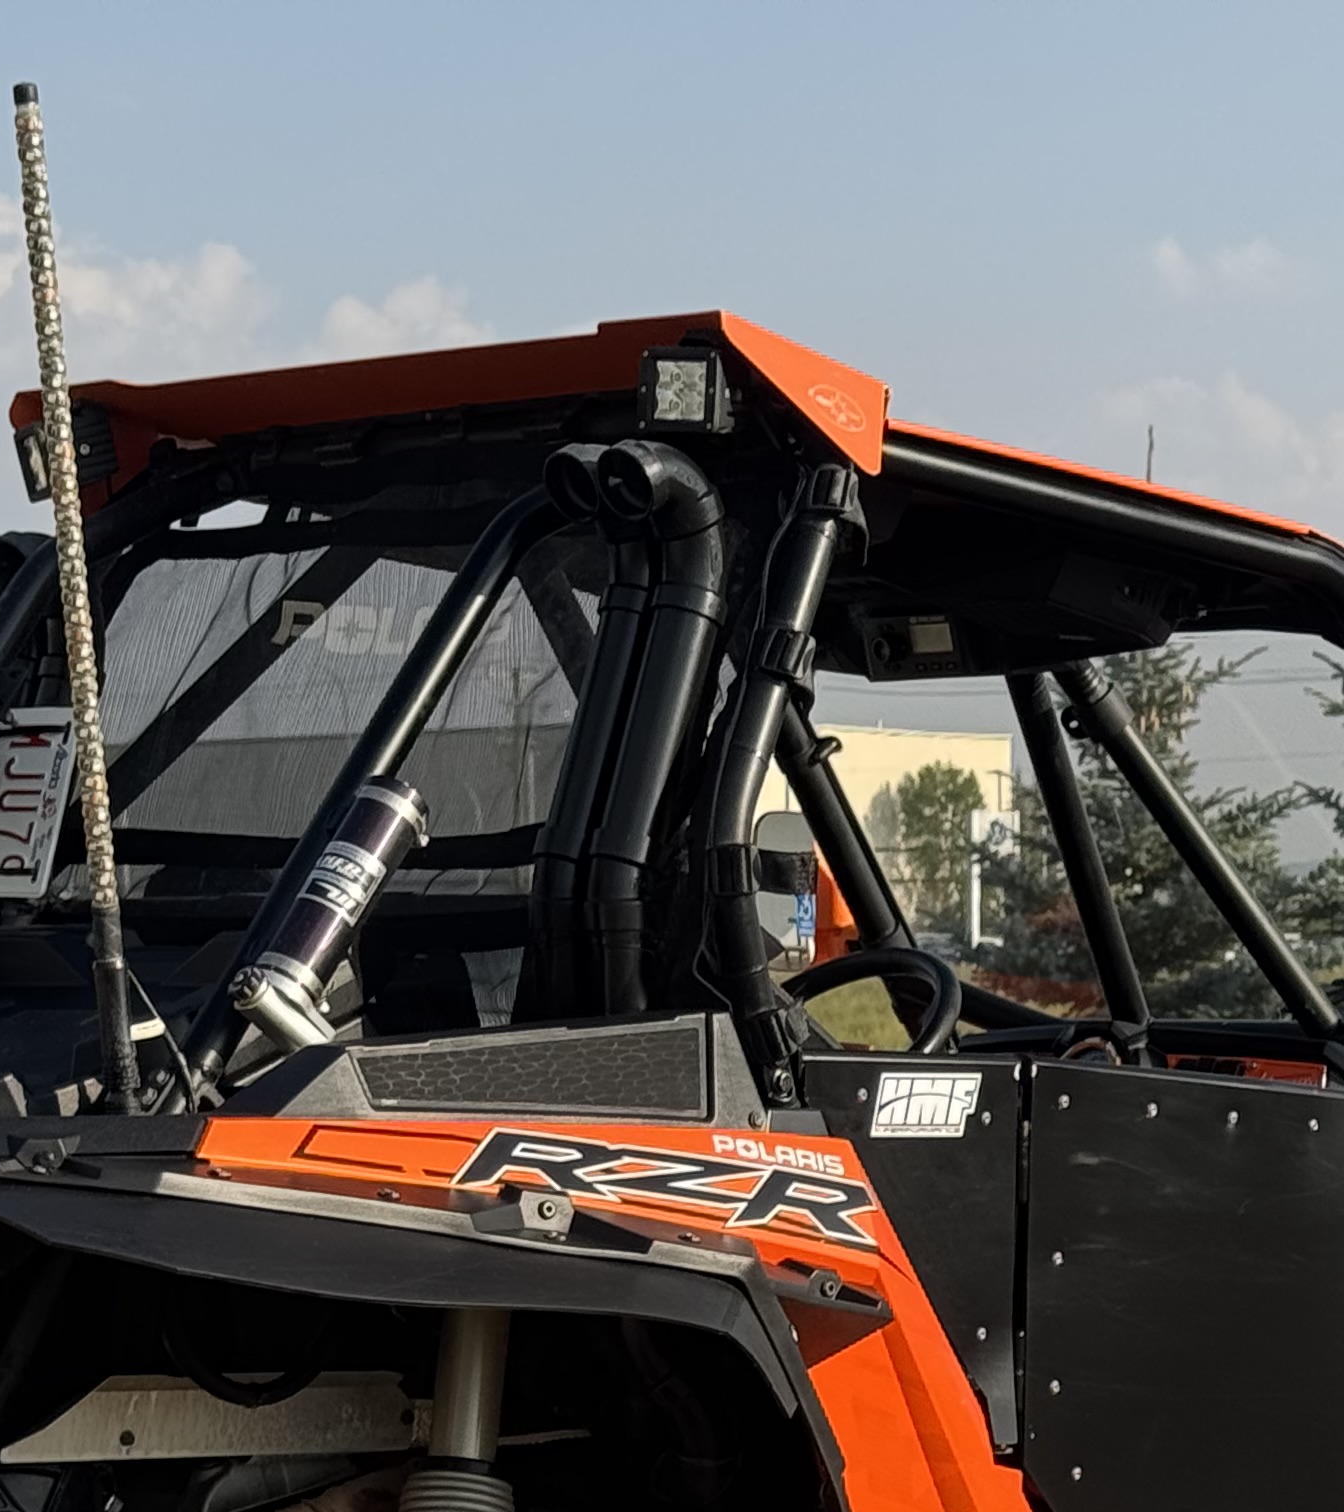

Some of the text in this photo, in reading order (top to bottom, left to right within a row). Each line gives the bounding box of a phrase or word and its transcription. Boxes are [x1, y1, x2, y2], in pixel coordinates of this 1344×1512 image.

[876, 1078, 979, 1126] HMF
[712, 1134, 845, 1176] POLARIS
[451, 1128, 878, 1246] RZR
